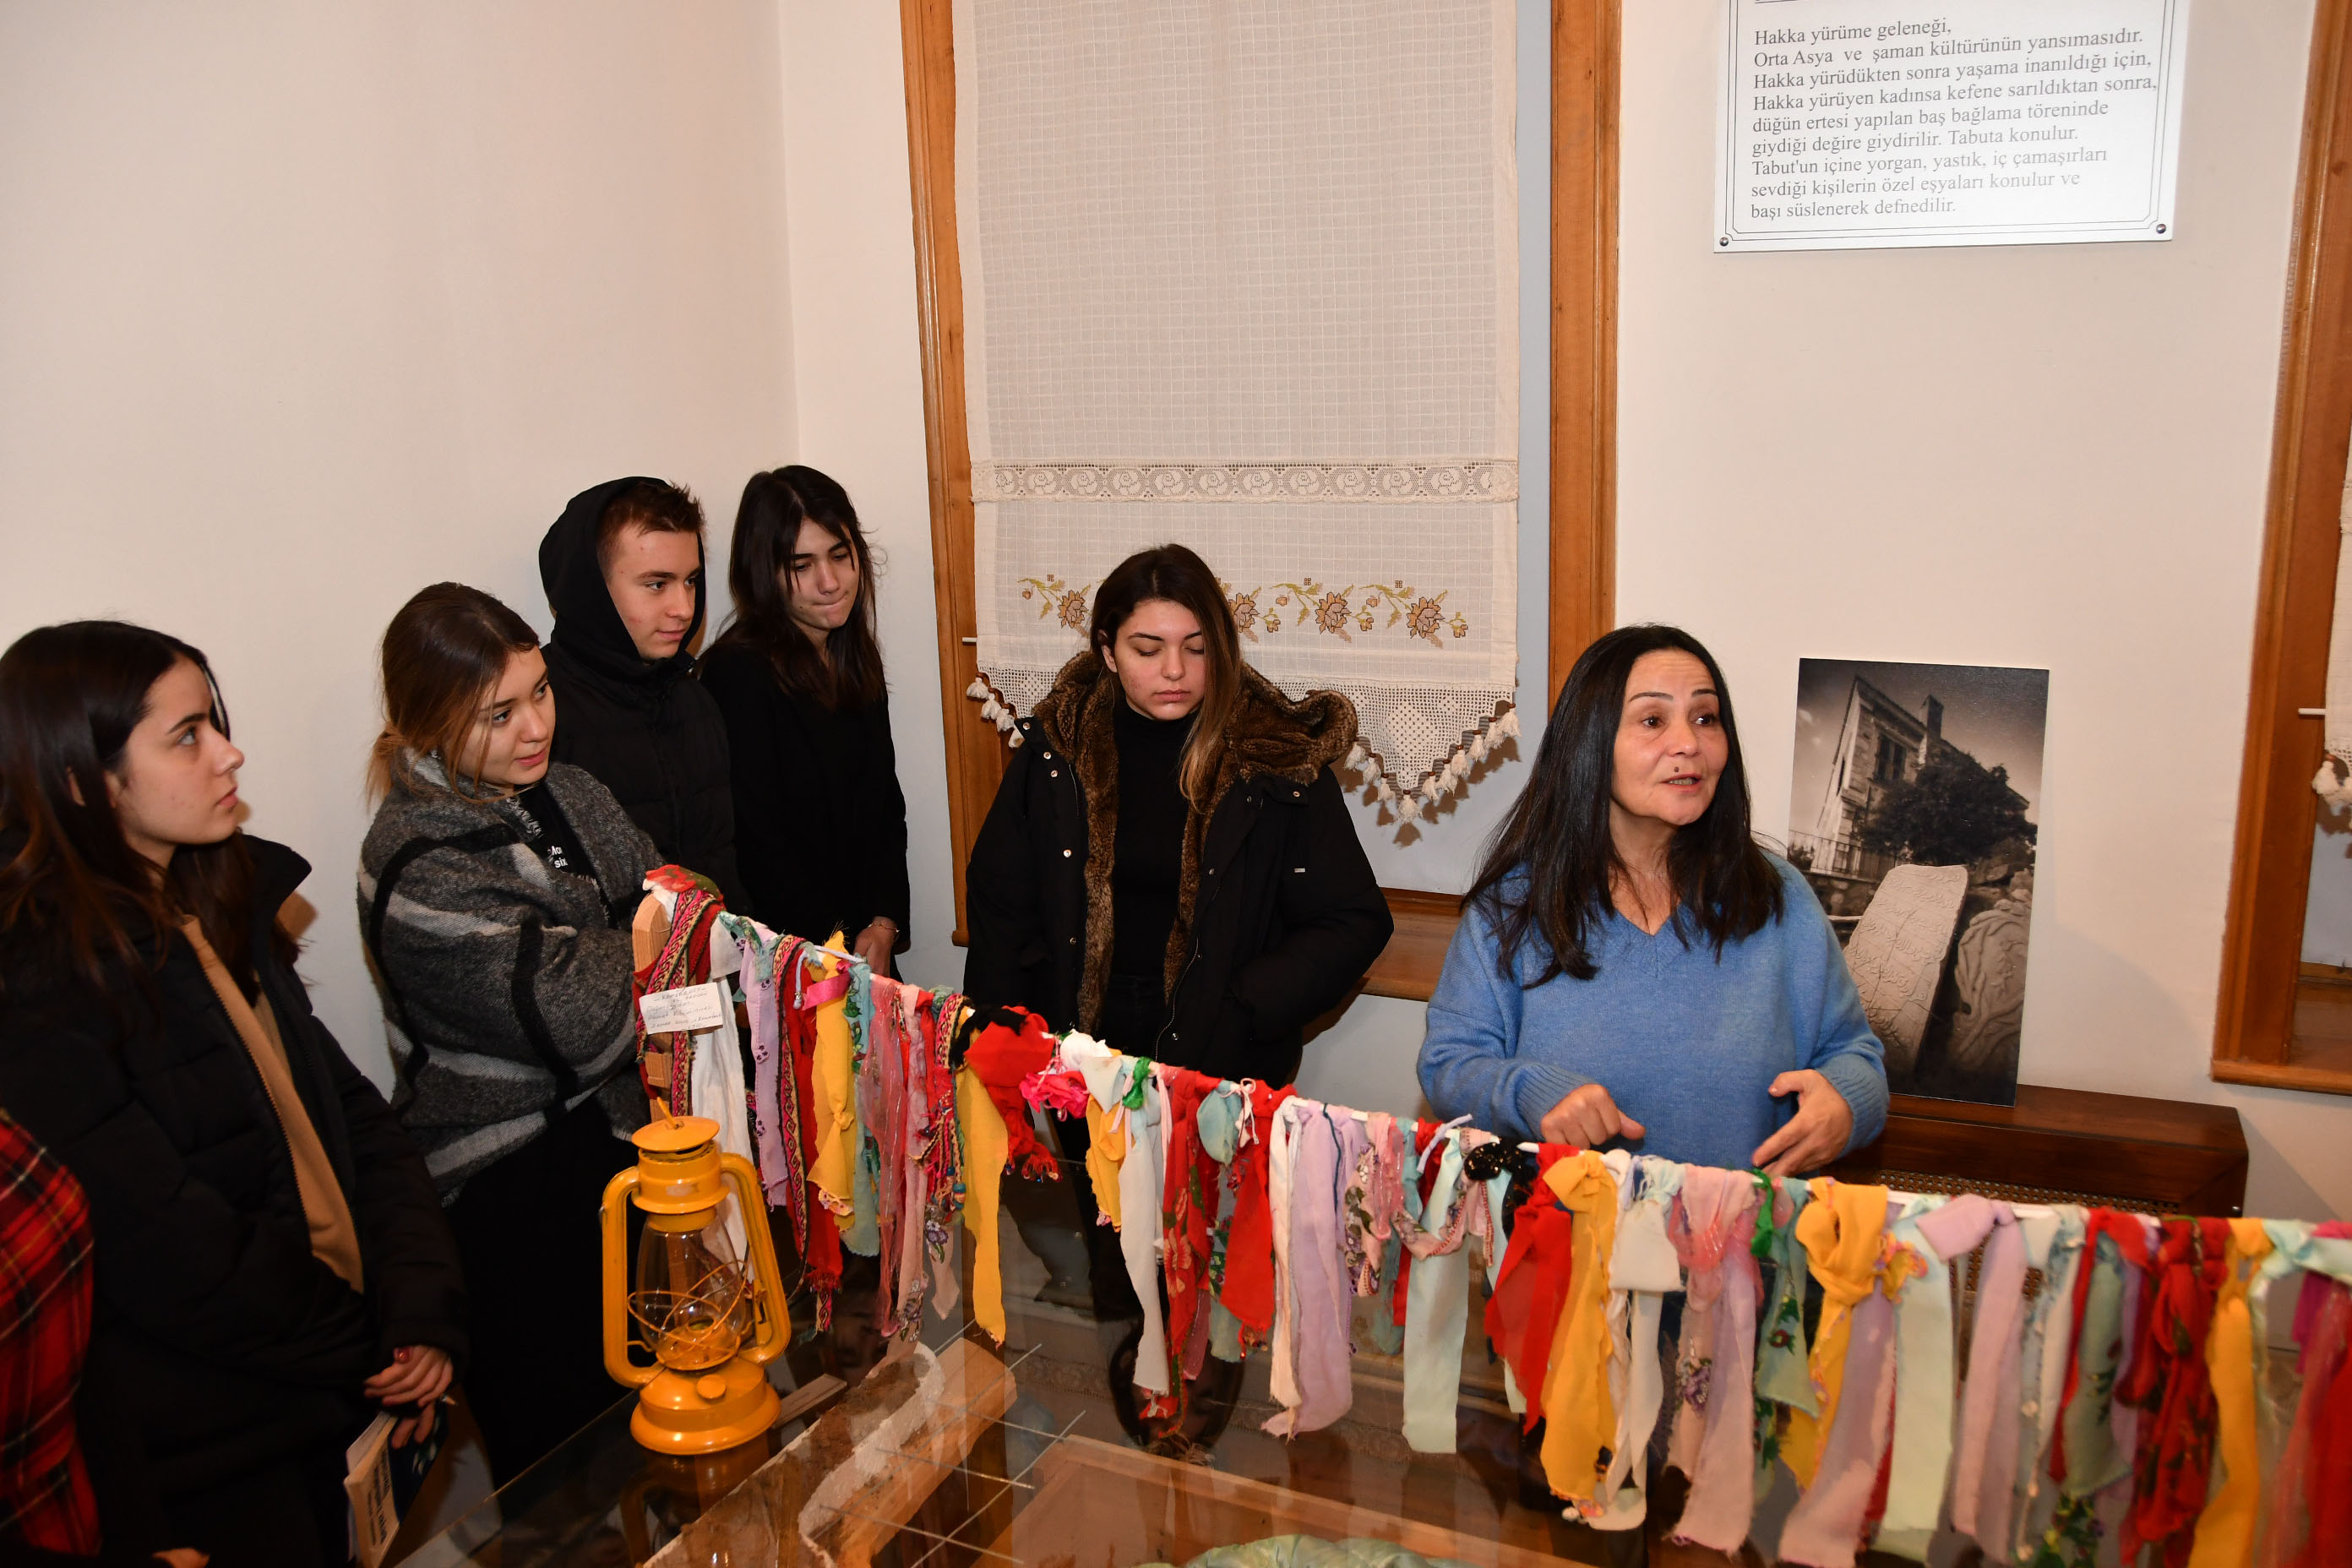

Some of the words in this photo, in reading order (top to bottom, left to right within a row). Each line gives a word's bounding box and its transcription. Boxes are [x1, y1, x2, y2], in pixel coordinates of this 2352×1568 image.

[1755, 52, 1788, 67] Orta
[1793, 51, 1833, 68] Asya
[1844, 50, 1862, 61] ve
[1873, 46, 1924, 63] şaman
[1930, 36, 2021, 56] kültürünün
[2028, 28, 2142, 54] yansımasıdır.
[1756, 29, 1805, 45] Hakka
[1810, 25, 1871, 46] yürüme
[1877, 18, 1951, 41] geleneği,
[1755, 73, 1805, 89] Hakka
[1810, 68, 1900, 90] yürüdükten
[1907, 68, 1950, 79] sonra
[1956, 63, 2018, 81] yaşama
[2025, 54, 2106, 73] inanıldığı
[2114, 50, 2151, 70] için,
[1754, 95, 1804, 111] Hakka
[1809, 92, 1873, 112] yürüyen
[1879, 88, 1941, 104] kadınsa
[1946, 84, 2002, 100] kefene
[2008, 79, 2098, 96] sarıldıktan
[2104, 78, 2157, 91] sonra,
[1753, 117, 1800, 135] düğün
[1806, 113, 1848, 129] ertesi
[1854, 111, 1913, 131] yapılan
[1919, 109, 1946, 127] baş
[1952, 106, 2021, 125] bağlama
[2028, 100, 2108, 118] töreninde
[1752, 137, 1806, 158] giydiği
[1812, 135, 1861, 154] değire
[1867, 131, 1941, 153] giydirilir.
[1948, 129, 2003, 144] Tabuta
[2009, 125, 2077, 142] konulur.
[1752, 160, 1818, 175] Tabut'un
[1825, 157, 1862, 176] içine
[1867, 158, 1926, 175] yorgan,
[1933, 151, 1986, 172] yastık,
[1994, 150, 2006, 169] iç
[2013, 146, 2106, 168] çamaşırları
[1751, 181, 1806, 199] sevdiği
[1812, 178, 1876, 197] kişilerin
[1882, 177, 1914, 192] özel
[1921, 174, 1983, 193] eşyaları
[1990, 172, 2055, 188] konulur
[2061, 174, 2080, 185] ve
[1751, 204, 1780, 220] başı
[1787, 200, 1869, 217] süslenerek
[1875, 197, 1956, 214] defnedilir.
